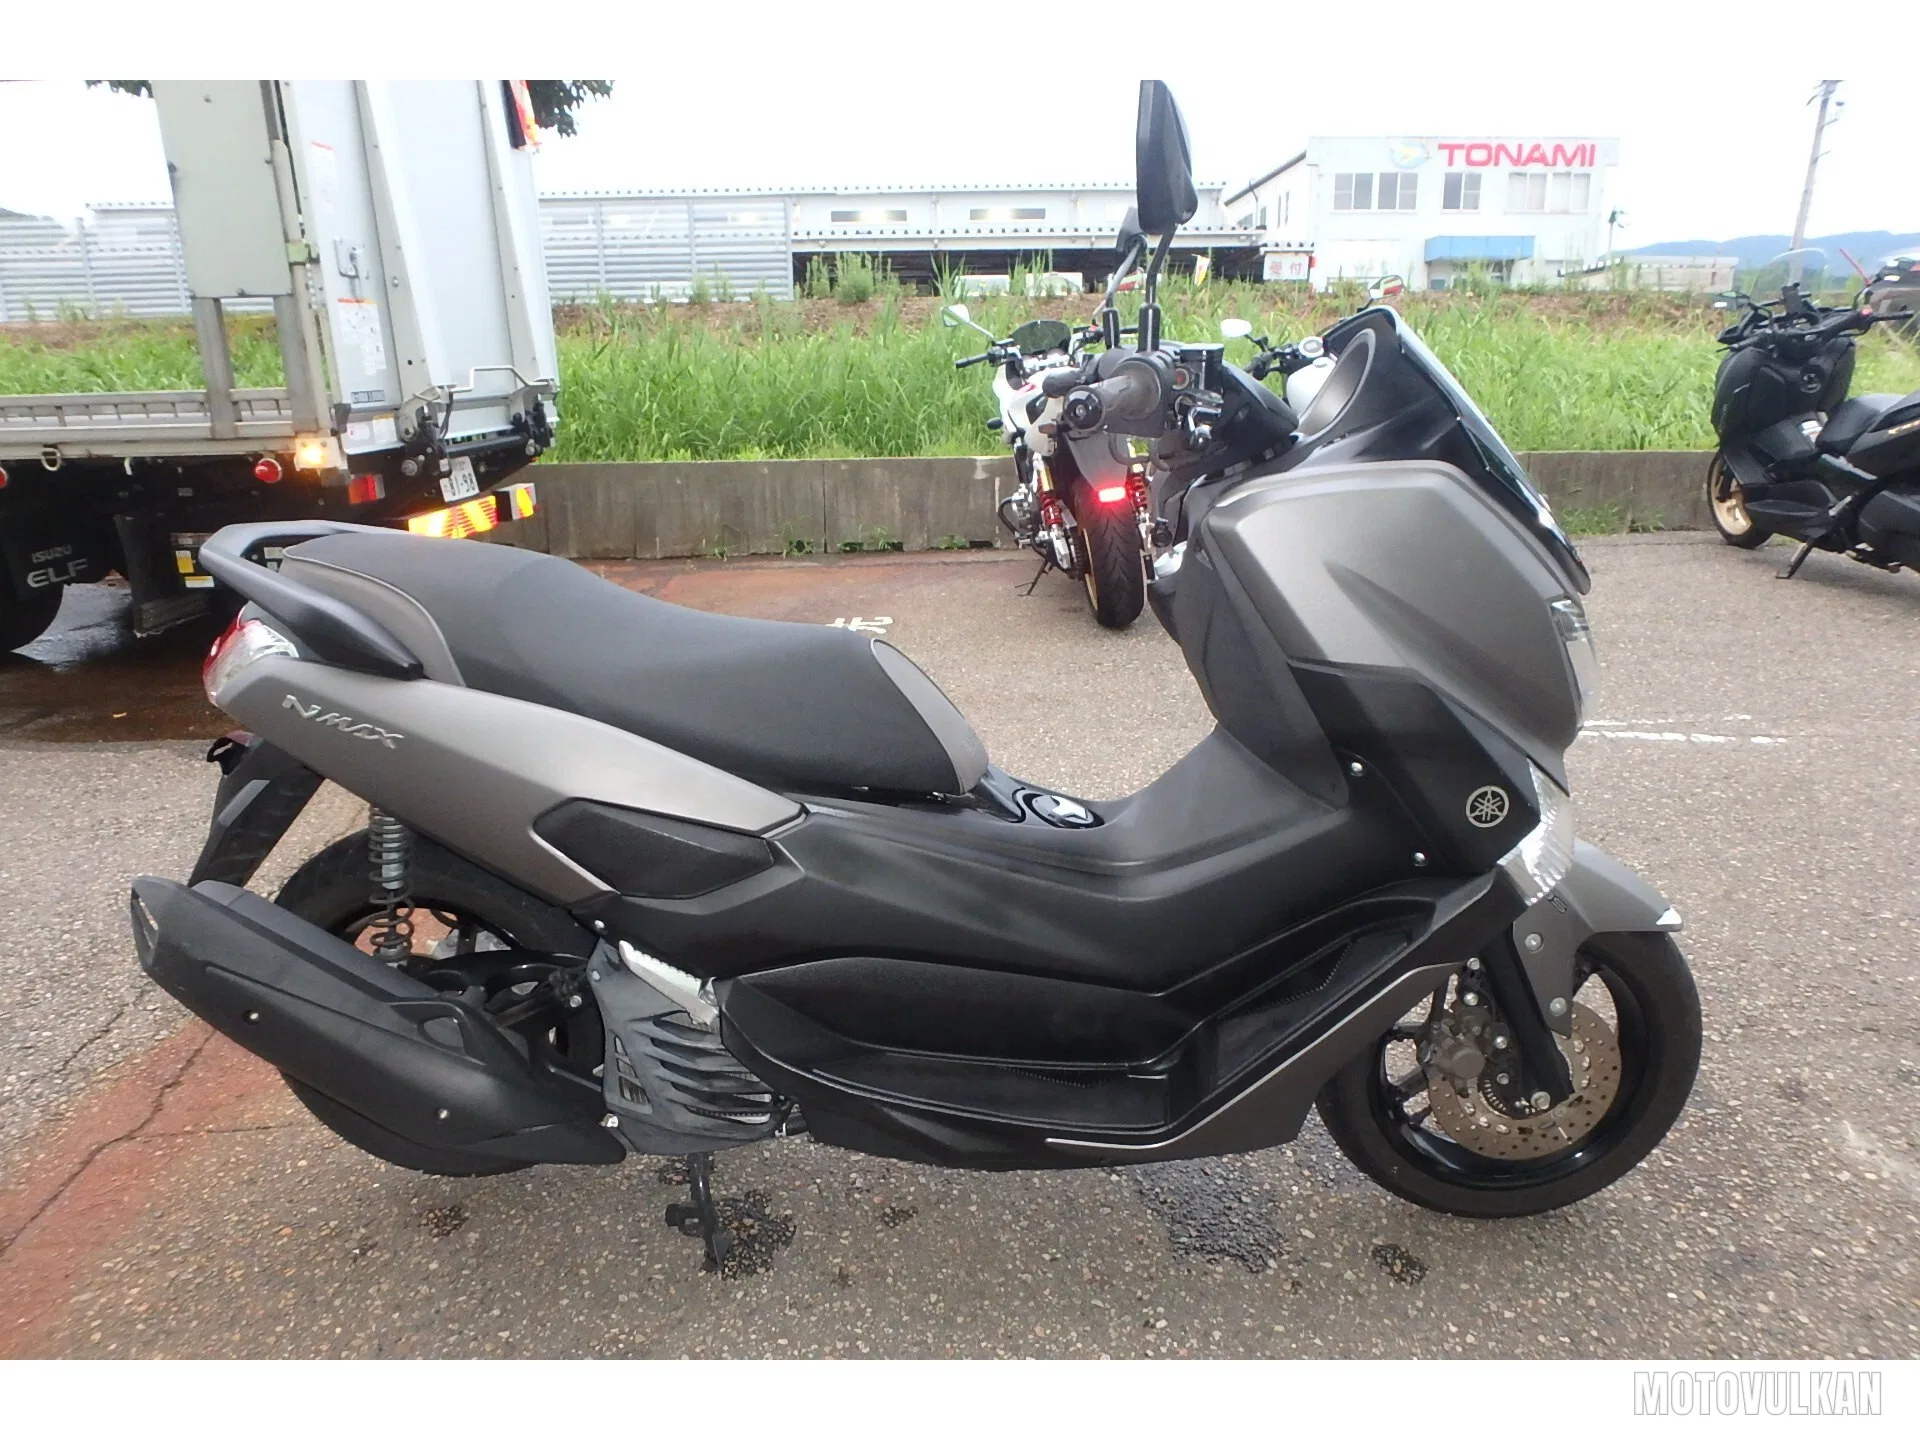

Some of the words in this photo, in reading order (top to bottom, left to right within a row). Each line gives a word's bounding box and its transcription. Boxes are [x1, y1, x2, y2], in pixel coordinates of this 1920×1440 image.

[1437, 143, 1596, 167] TONAMI
[31, 544, 73, 563] ISUZU
[27, 558, 89, 588] ELF
[281, 694, 404, 749] NMAX
